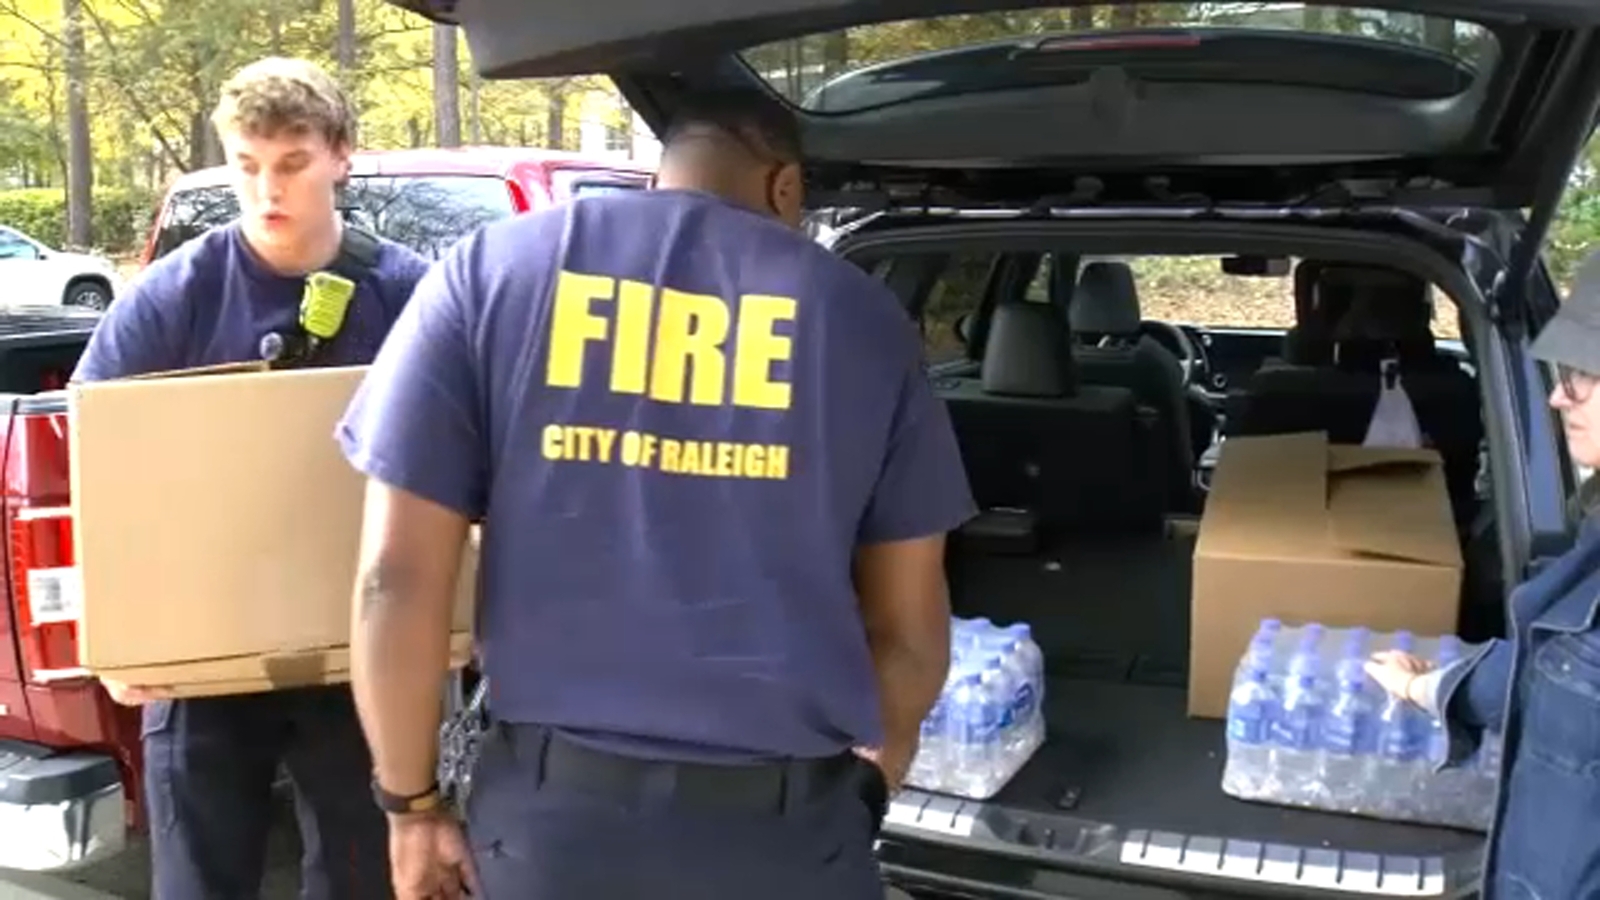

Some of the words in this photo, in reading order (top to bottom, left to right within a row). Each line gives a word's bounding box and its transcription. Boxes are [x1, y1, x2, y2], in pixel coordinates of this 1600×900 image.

[546, 270, 797, 409] FIRE
[542, 424, 617, 463] CITY
[620, 430, 657, 468] OF
[659, 438, 790, 480] RALEIGH
